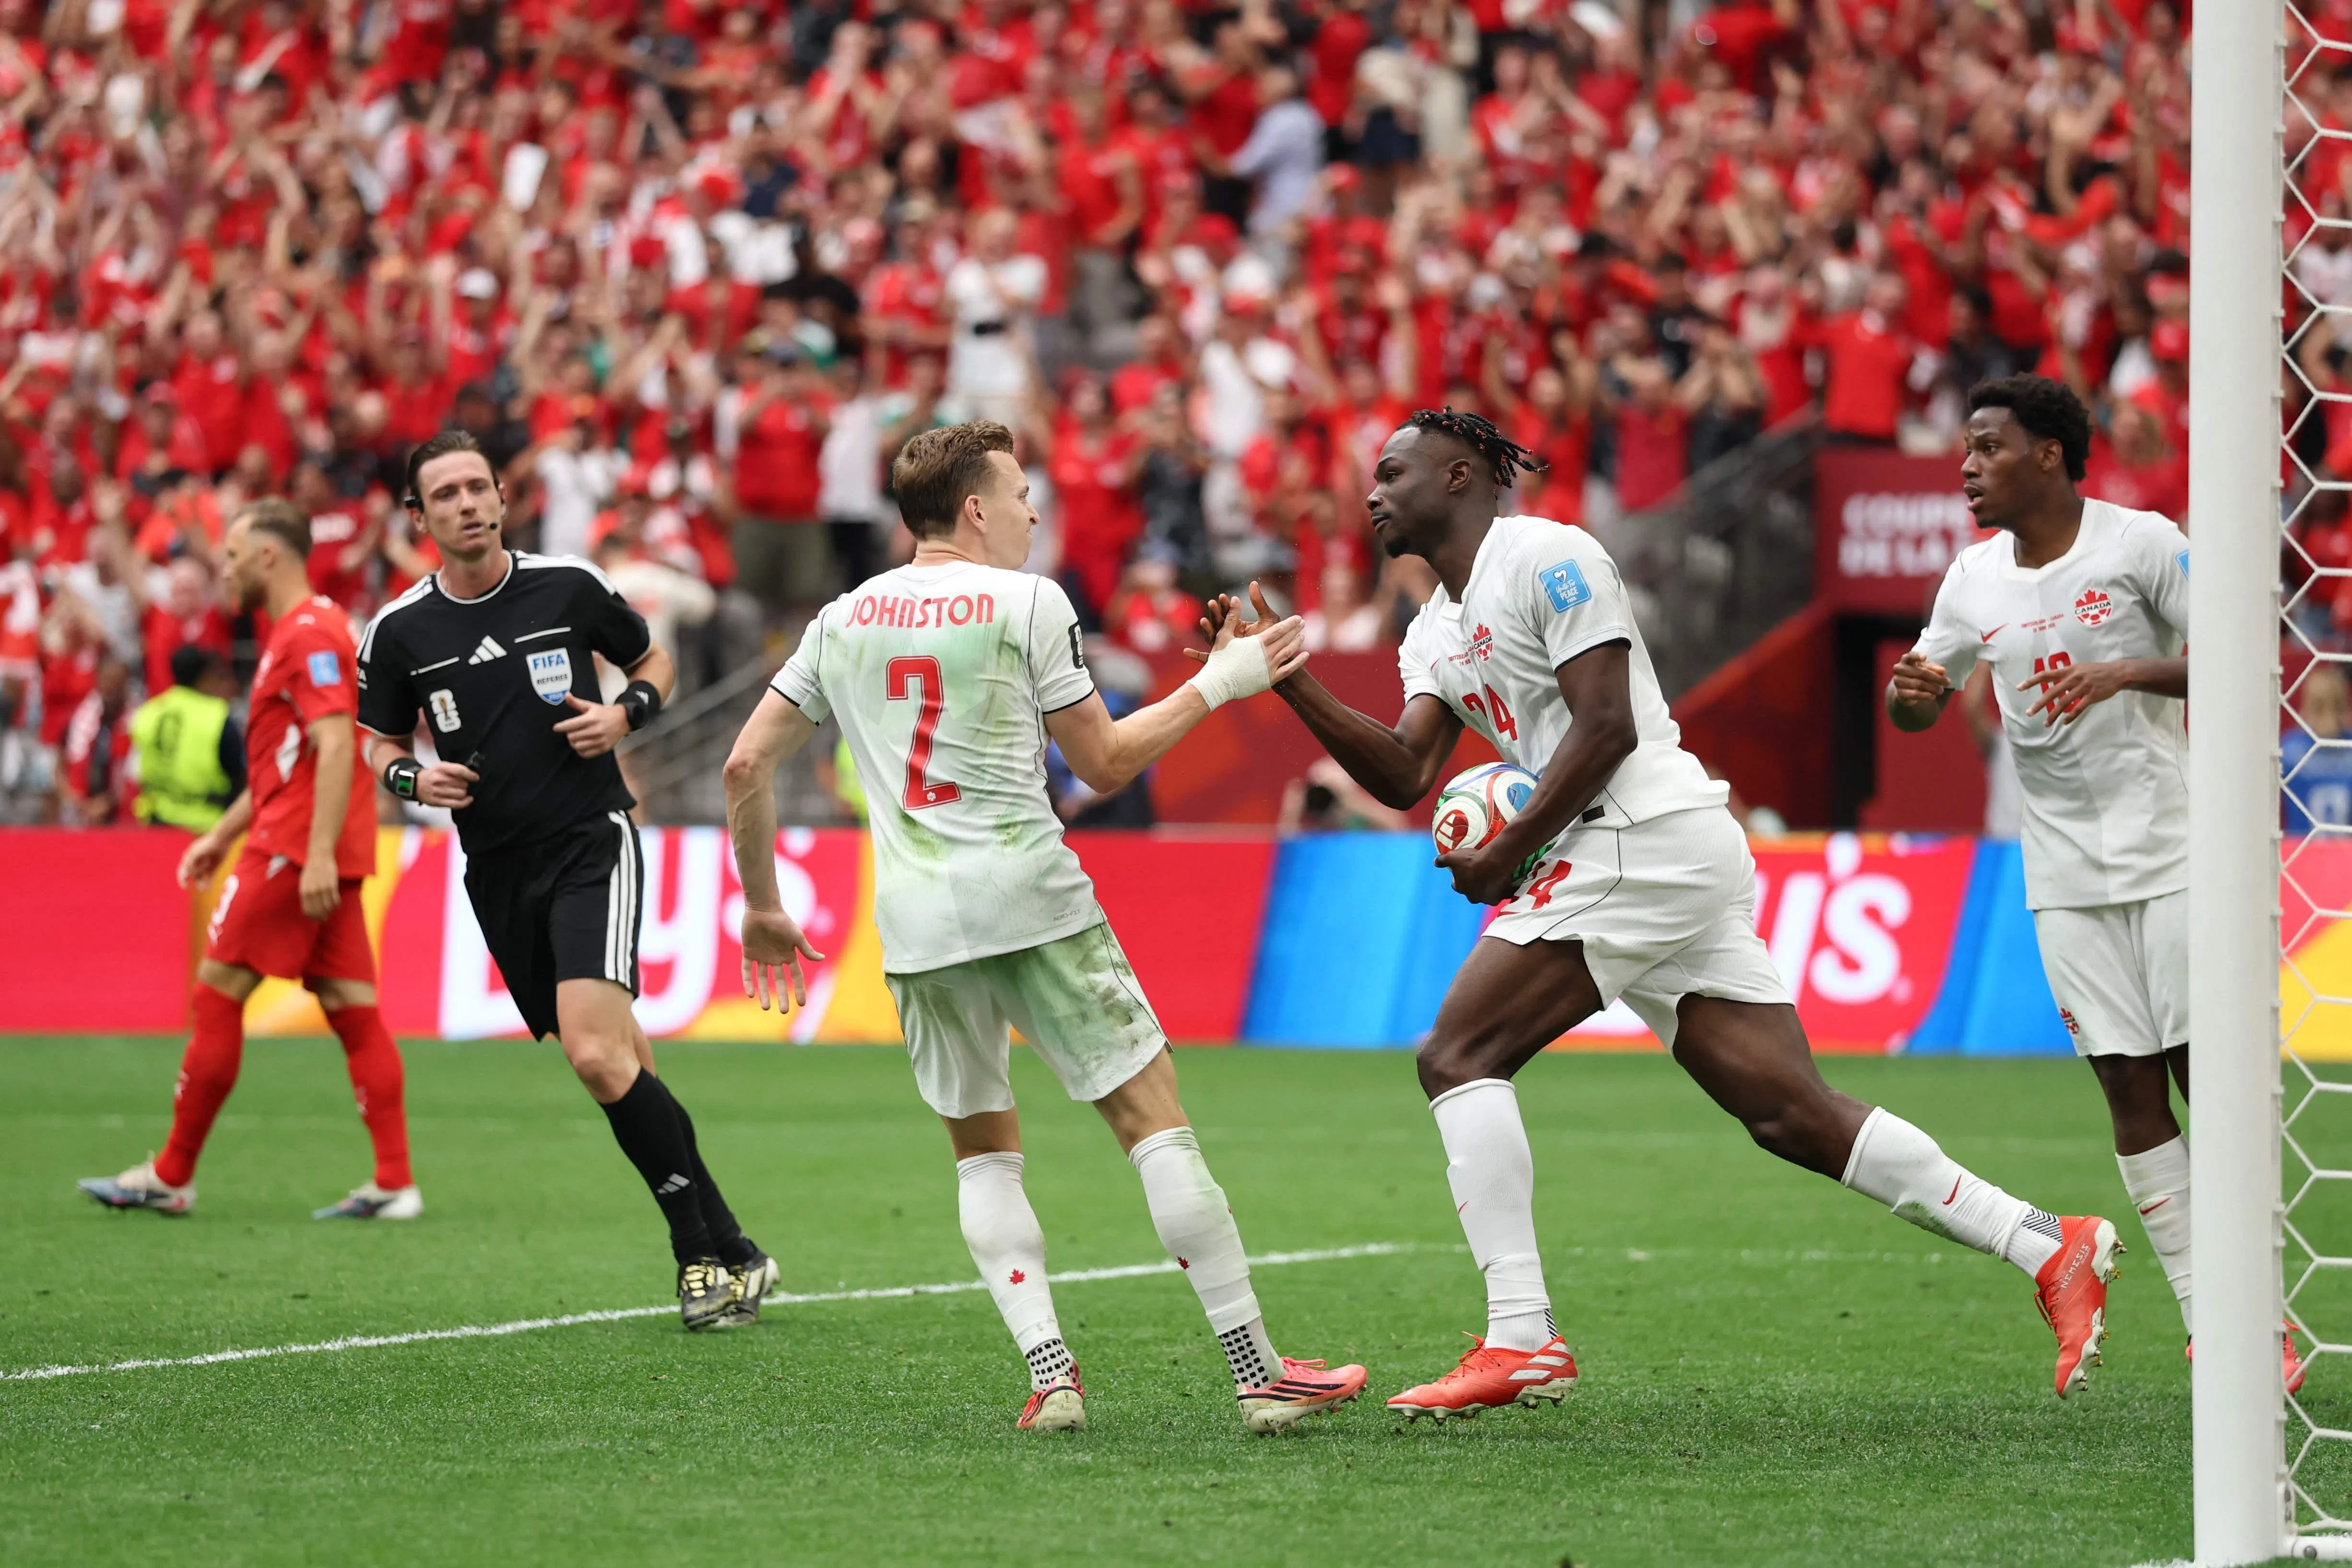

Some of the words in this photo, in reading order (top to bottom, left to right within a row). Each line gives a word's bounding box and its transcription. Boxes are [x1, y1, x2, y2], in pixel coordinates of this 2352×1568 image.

[1560, 586, 1579, 601] PEACE
[846, 594, 994, 628] JOHNSTON
[2074, 601, 2111, 614] CANADA
[1474, 636, 1492, 649] CANADA
[532, 654, 565, 670] FIFA
[536, 673, 567, 685] REFEREE
[1462, 683, 1518, 742] 24
[886, 655, 962, 811] 2
